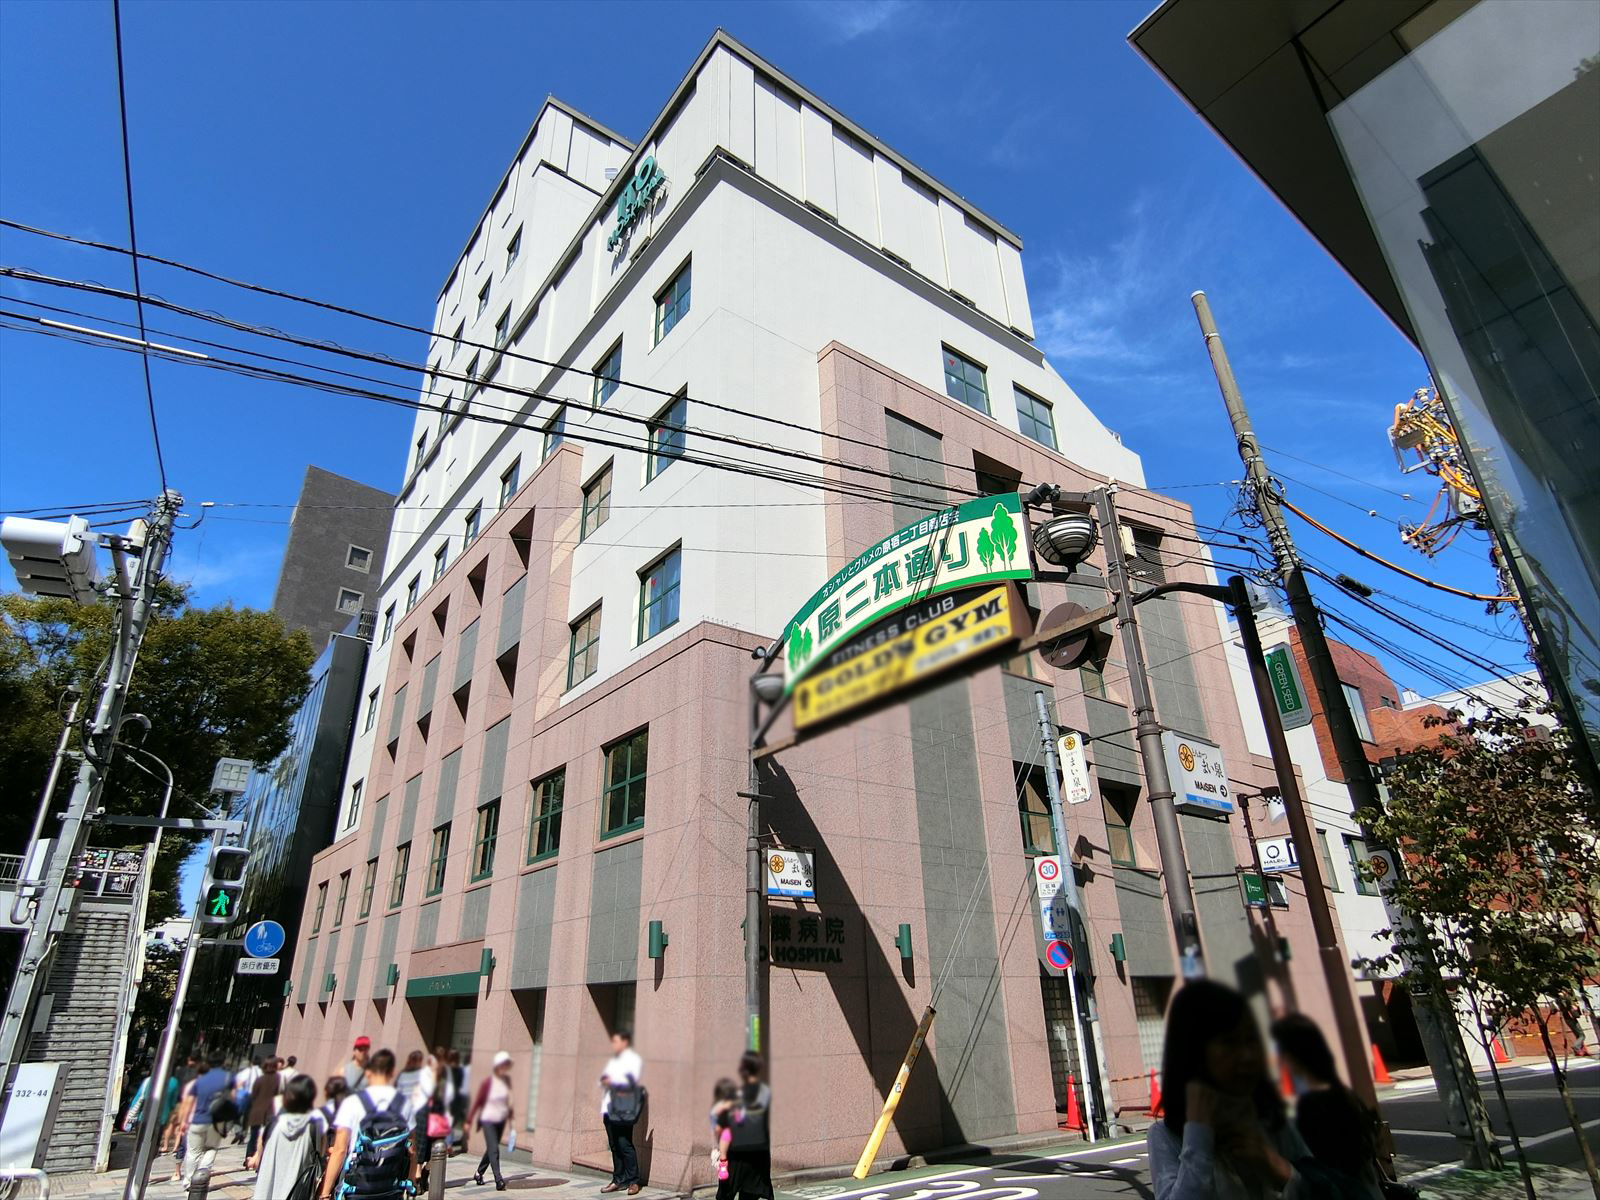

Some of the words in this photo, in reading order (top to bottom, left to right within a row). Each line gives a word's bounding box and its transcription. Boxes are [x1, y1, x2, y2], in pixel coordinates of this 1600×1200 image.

[818, 531, 970, 645] 原二本通り
[832, 624, 900, 665] FITNESS
[905, 597, 954, 630] CLUB
[923, 596, 1002, 646] GYM
[1274, 662, 1288, 689] GREEN
[1281, 688, 1295, 710] SEED
[1043, 864, 1055, 875] 30
[241, 961, 278, 971] 歩行者優先
[775, 946, 843, 963] HOSPITAL
[16, 1089, 48, 1098] 332-44
